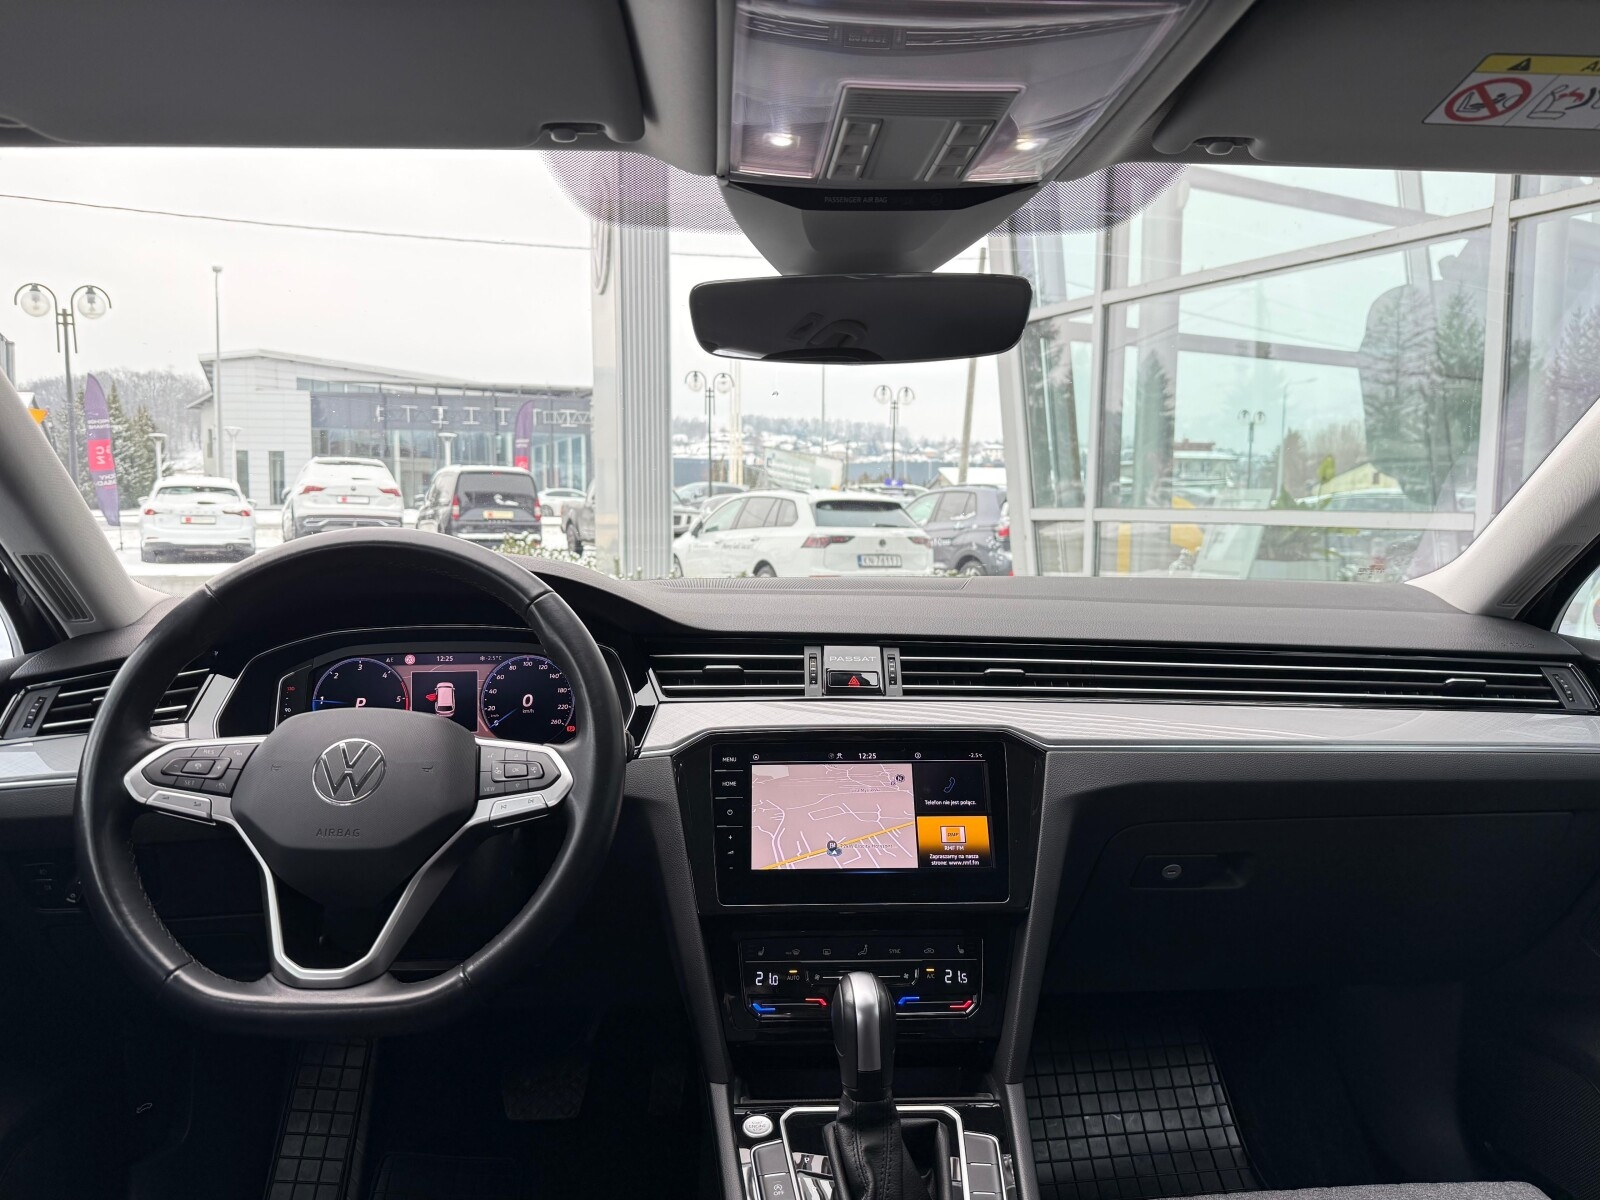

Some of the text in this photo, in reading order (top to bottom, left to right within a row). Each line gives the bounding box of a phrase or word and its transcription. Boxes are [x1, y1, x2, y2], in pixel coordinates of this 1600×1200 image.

[824, 196, 888, 204] PASSENGER AIR BAG
[357, 663, 363, 671] 3
[355, 697, 367, 709] P
[396, 695, 402, 703] 5
[522, 693, 534, 708] 0
[858, 752, 877, 760] 12:25
[315, 828, 361, 837] AIRBAG
